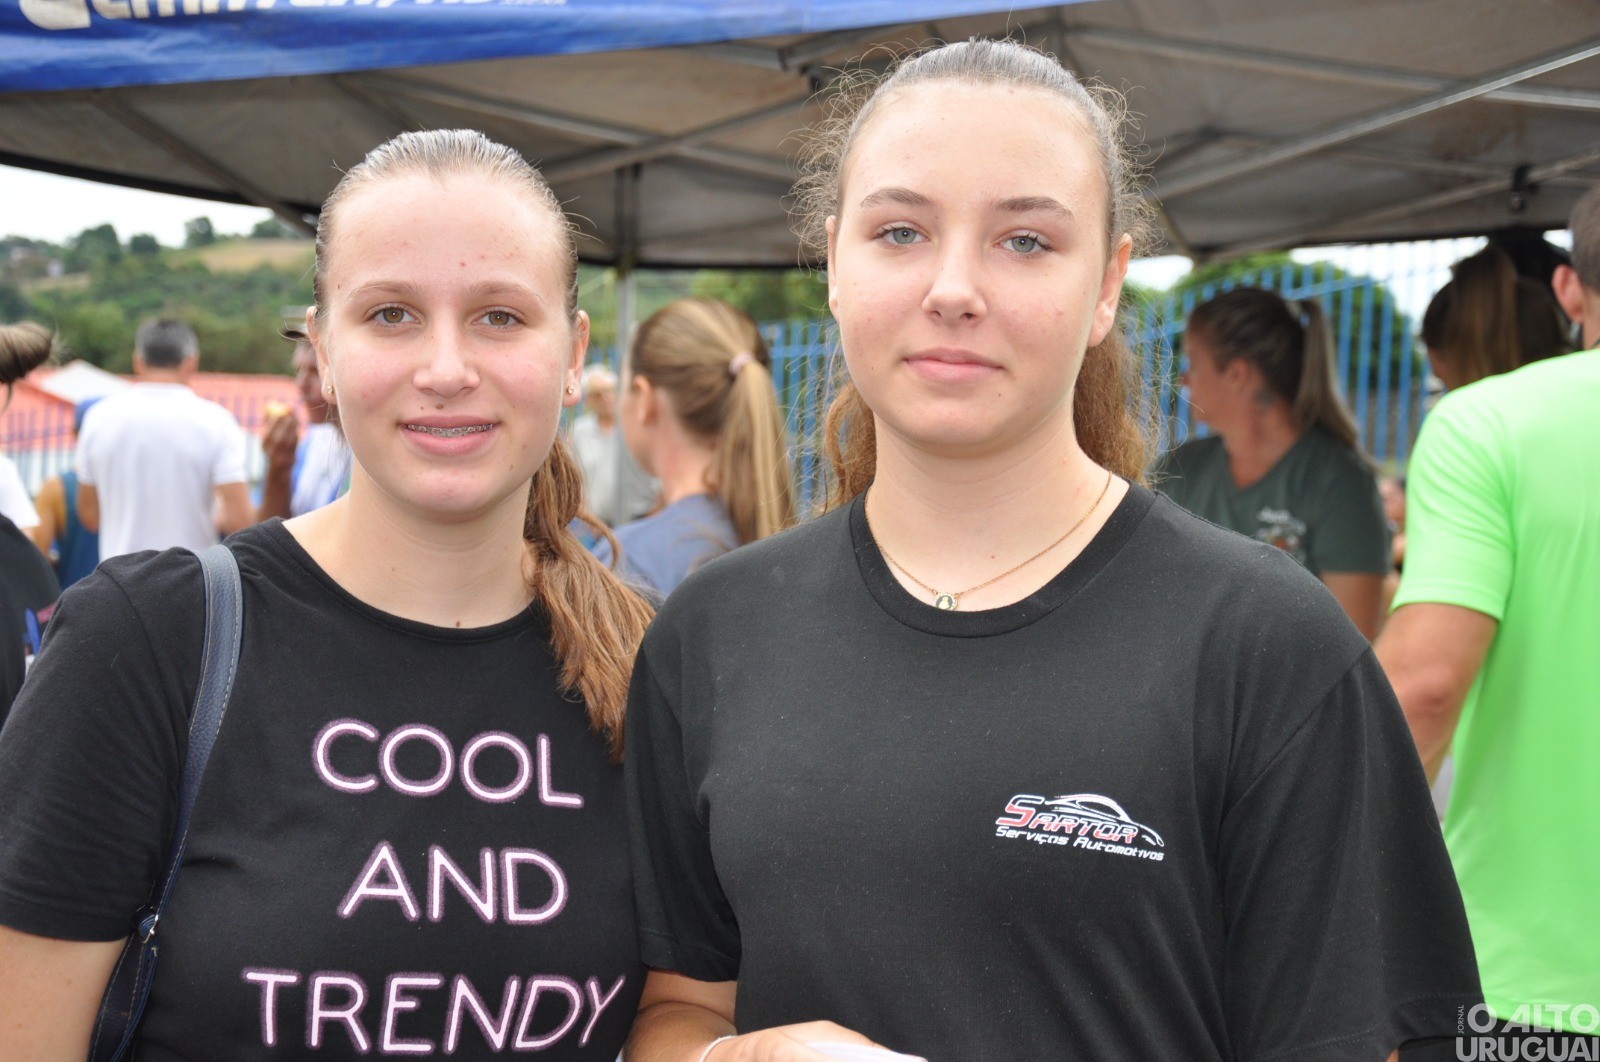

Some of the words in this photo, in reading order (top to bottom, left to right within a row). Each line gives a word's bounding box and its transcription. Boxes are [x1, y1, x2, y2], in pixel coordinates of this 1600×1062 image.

[312, 718, 584, 809] COOL
[995, 794, 1139, 844] SARTOR
[995, 826, 1070, 846] Serviços
[1072, 836, 1165, 862] Automotivos
[337, 840, 568, 926] AND
[242, 967, 626, 1054] TRENDY
